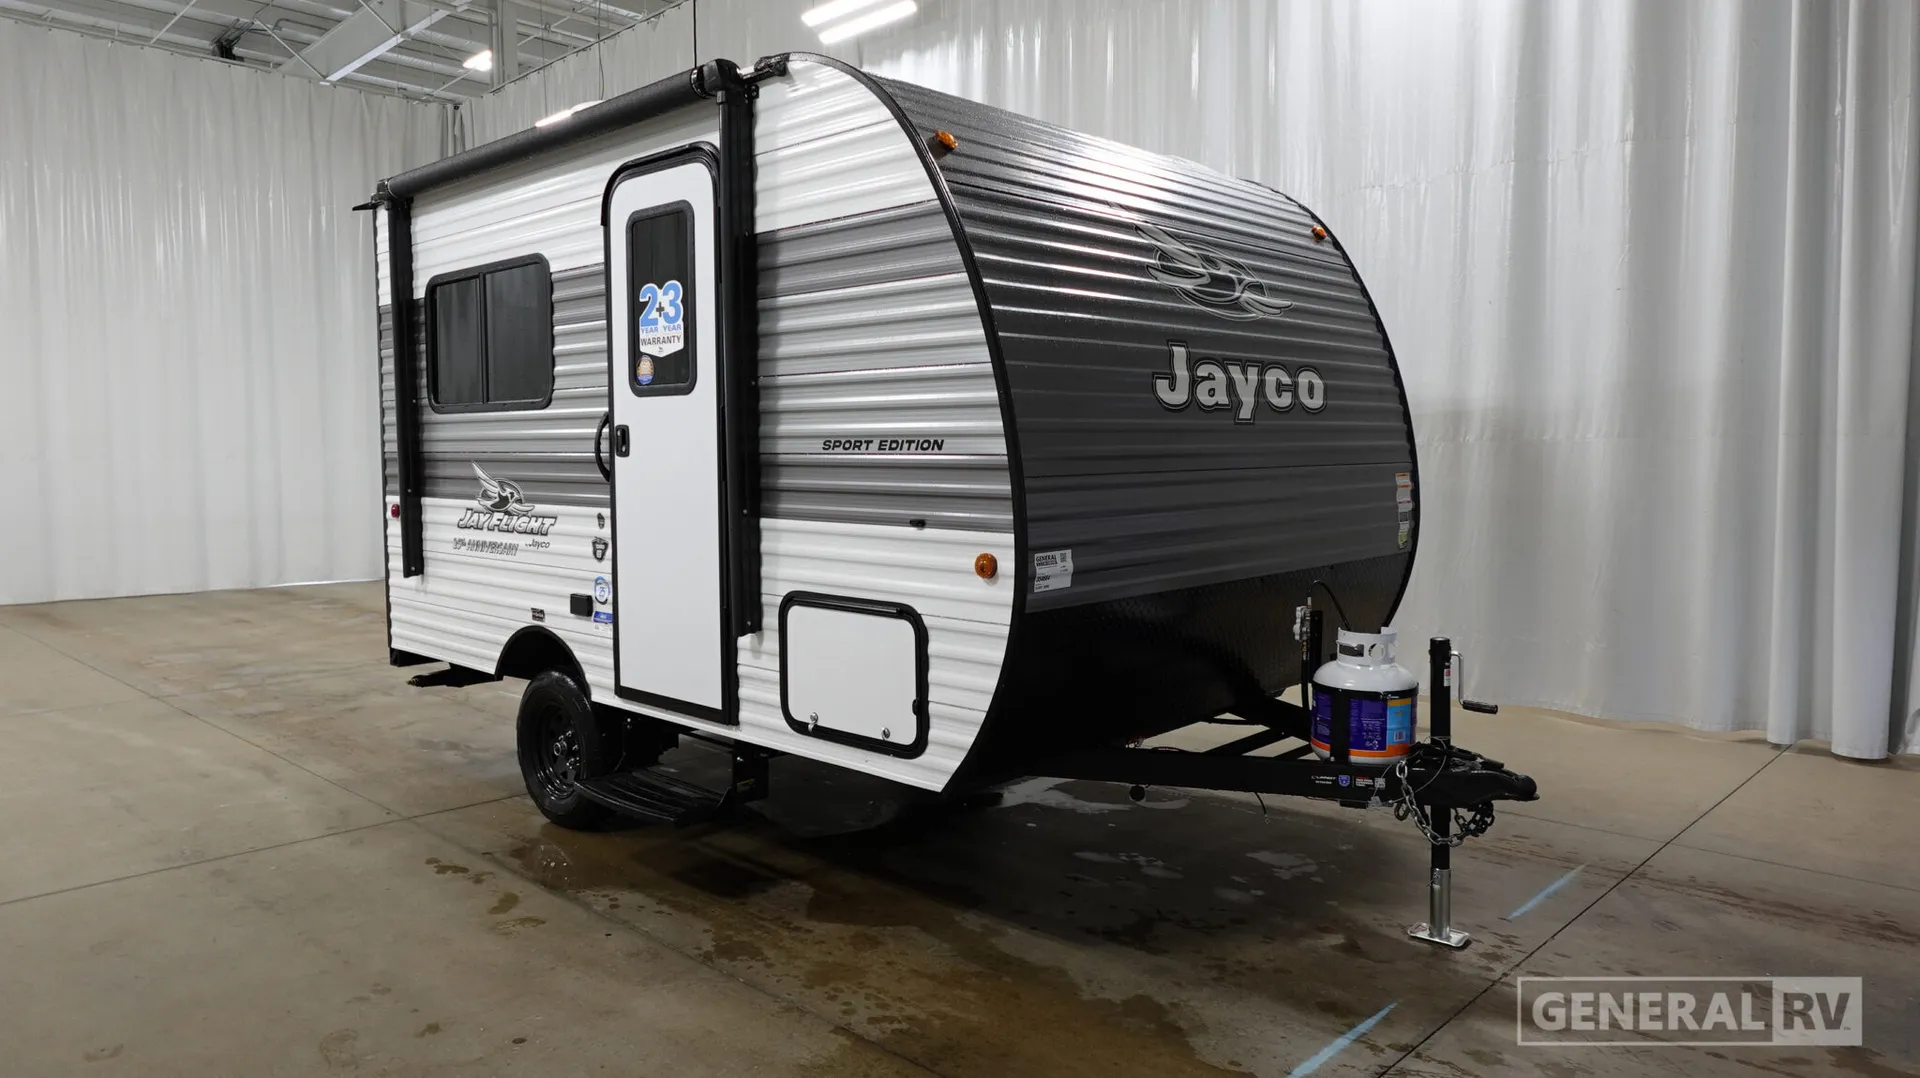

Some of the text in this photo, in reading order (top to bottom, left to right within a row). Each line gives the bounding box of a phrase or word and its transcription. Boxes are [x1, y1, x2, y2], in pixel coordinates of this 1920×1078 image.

[641, 335, 681, 346] WARRANTY
[1153, 340, 1327, 424] Jayco
[822, 439, 944, 451] SPORT EDITION
